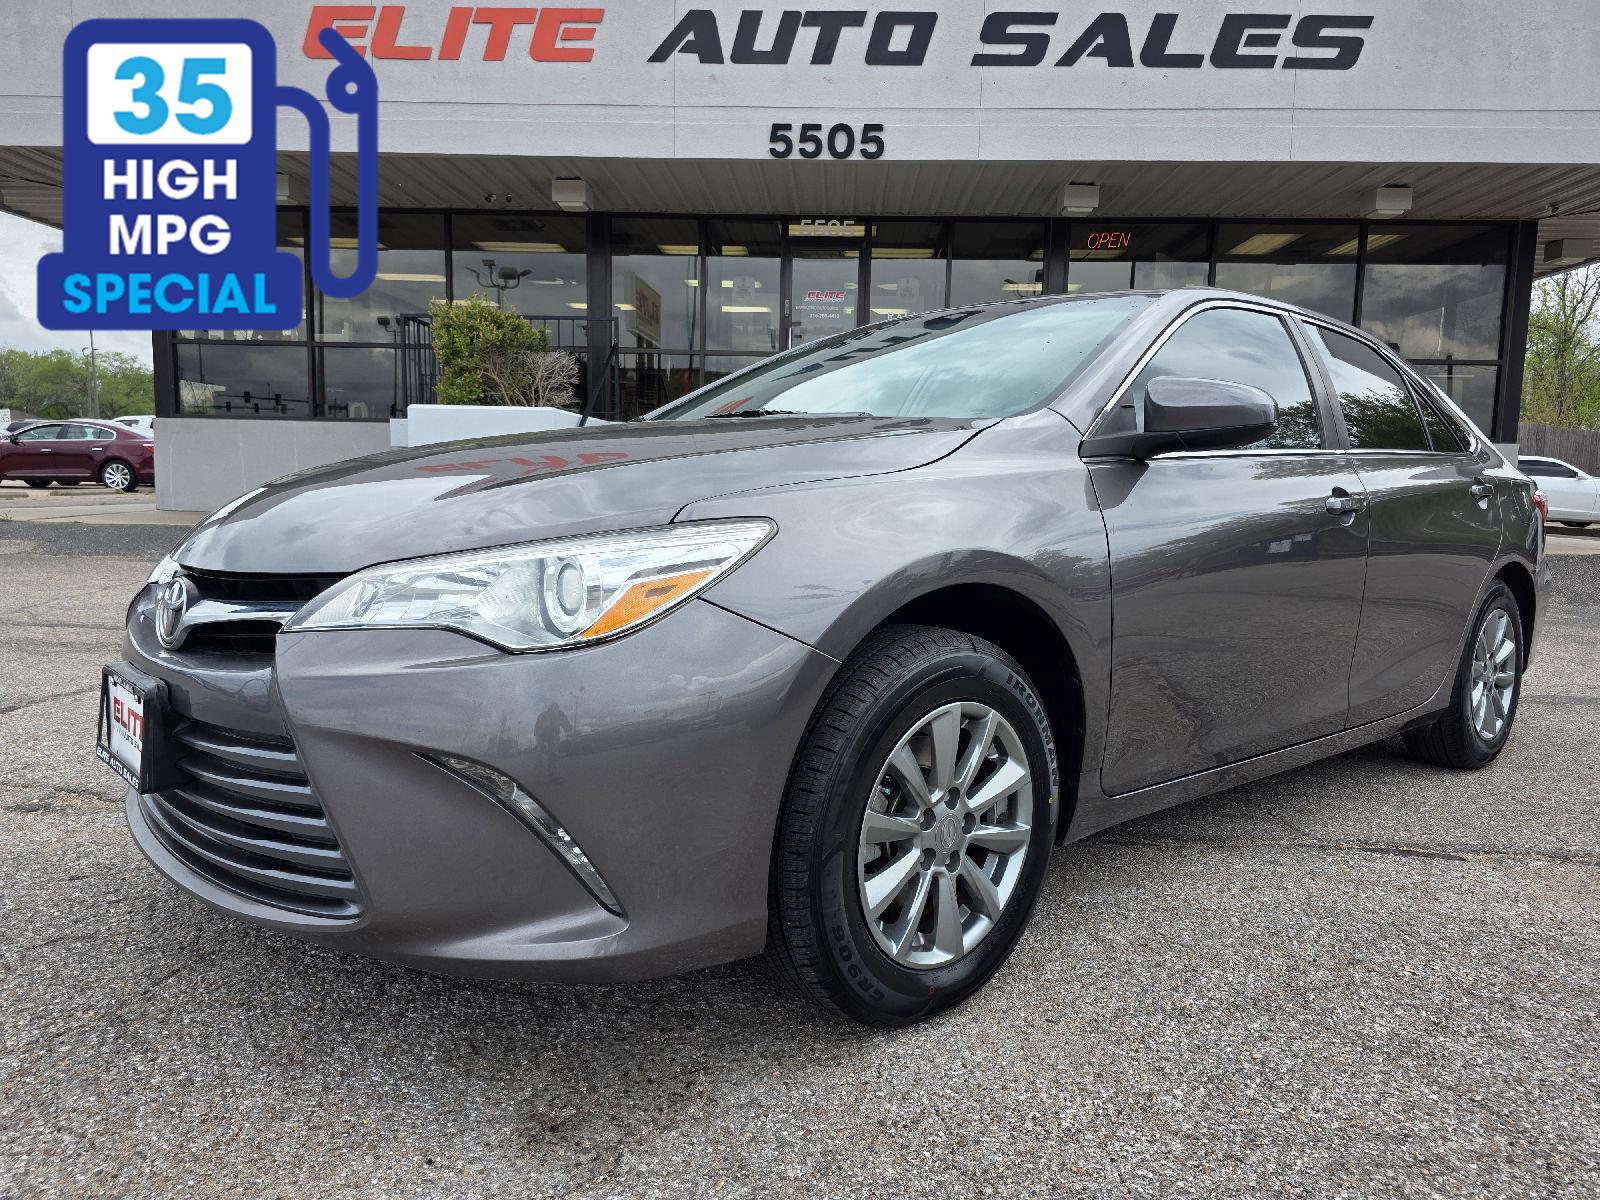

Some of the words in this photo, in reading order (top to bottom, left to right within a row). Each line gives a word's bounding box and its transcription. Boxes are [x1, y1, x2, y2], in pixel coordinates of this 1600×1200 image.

[302, 6, 605, 62] ELITE
[647, 10, 938, 66] AUTO
[970, 12, 1374, 70] SALES
[769, 123, 885, 159] 5505
[1087, 231, 1132, 249] OPEN
[807, 290, 845, 299] ELITE
[1006, 673, 1059, 787] IRONMAN
[123, 768, 140, 790] SALES
